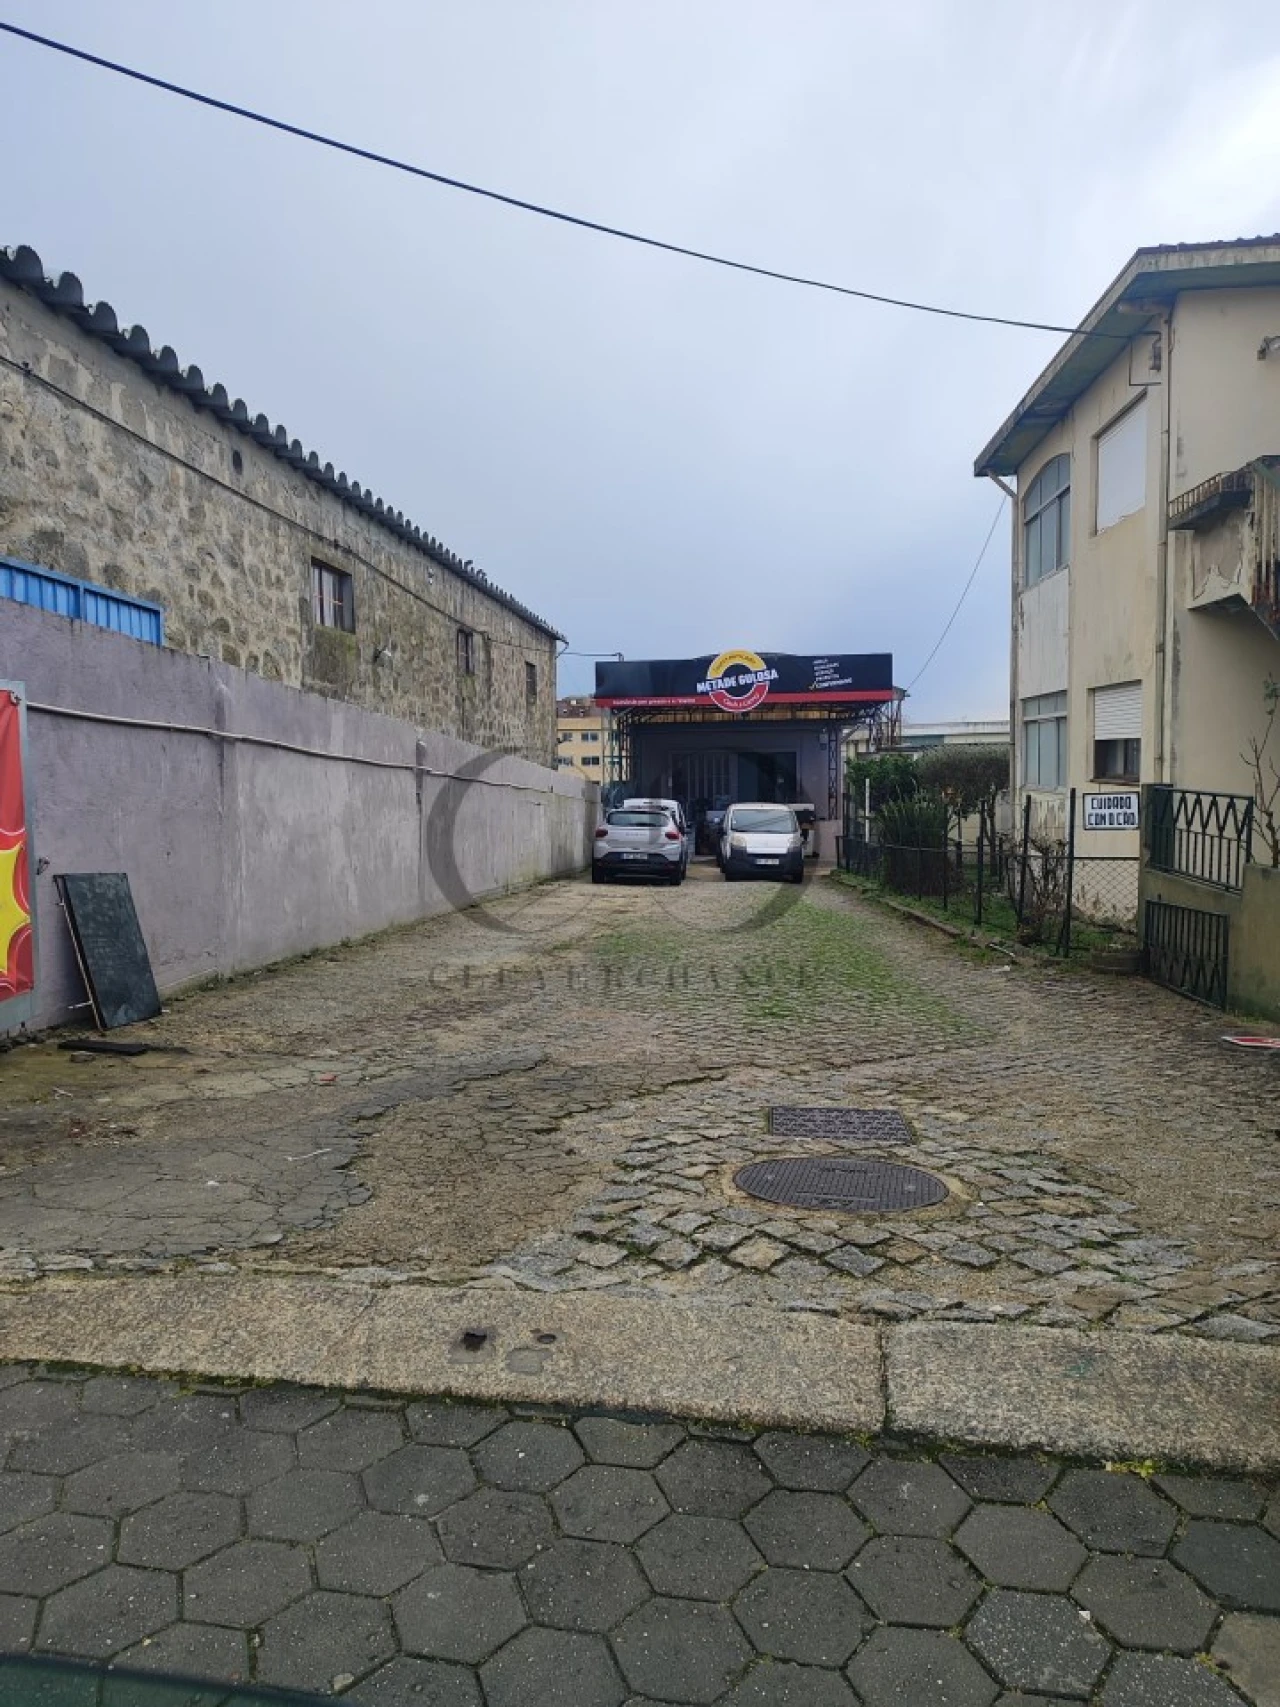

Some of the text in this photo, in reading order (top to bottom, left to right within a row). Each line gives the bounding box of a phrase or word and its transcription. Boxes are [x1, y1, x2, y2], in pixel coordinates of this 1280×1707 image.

[696, 675, 737, 693] METADE
[1091, 796, 1131, 810] CUIDADO
[1088, 812, 1106, 825] COM
